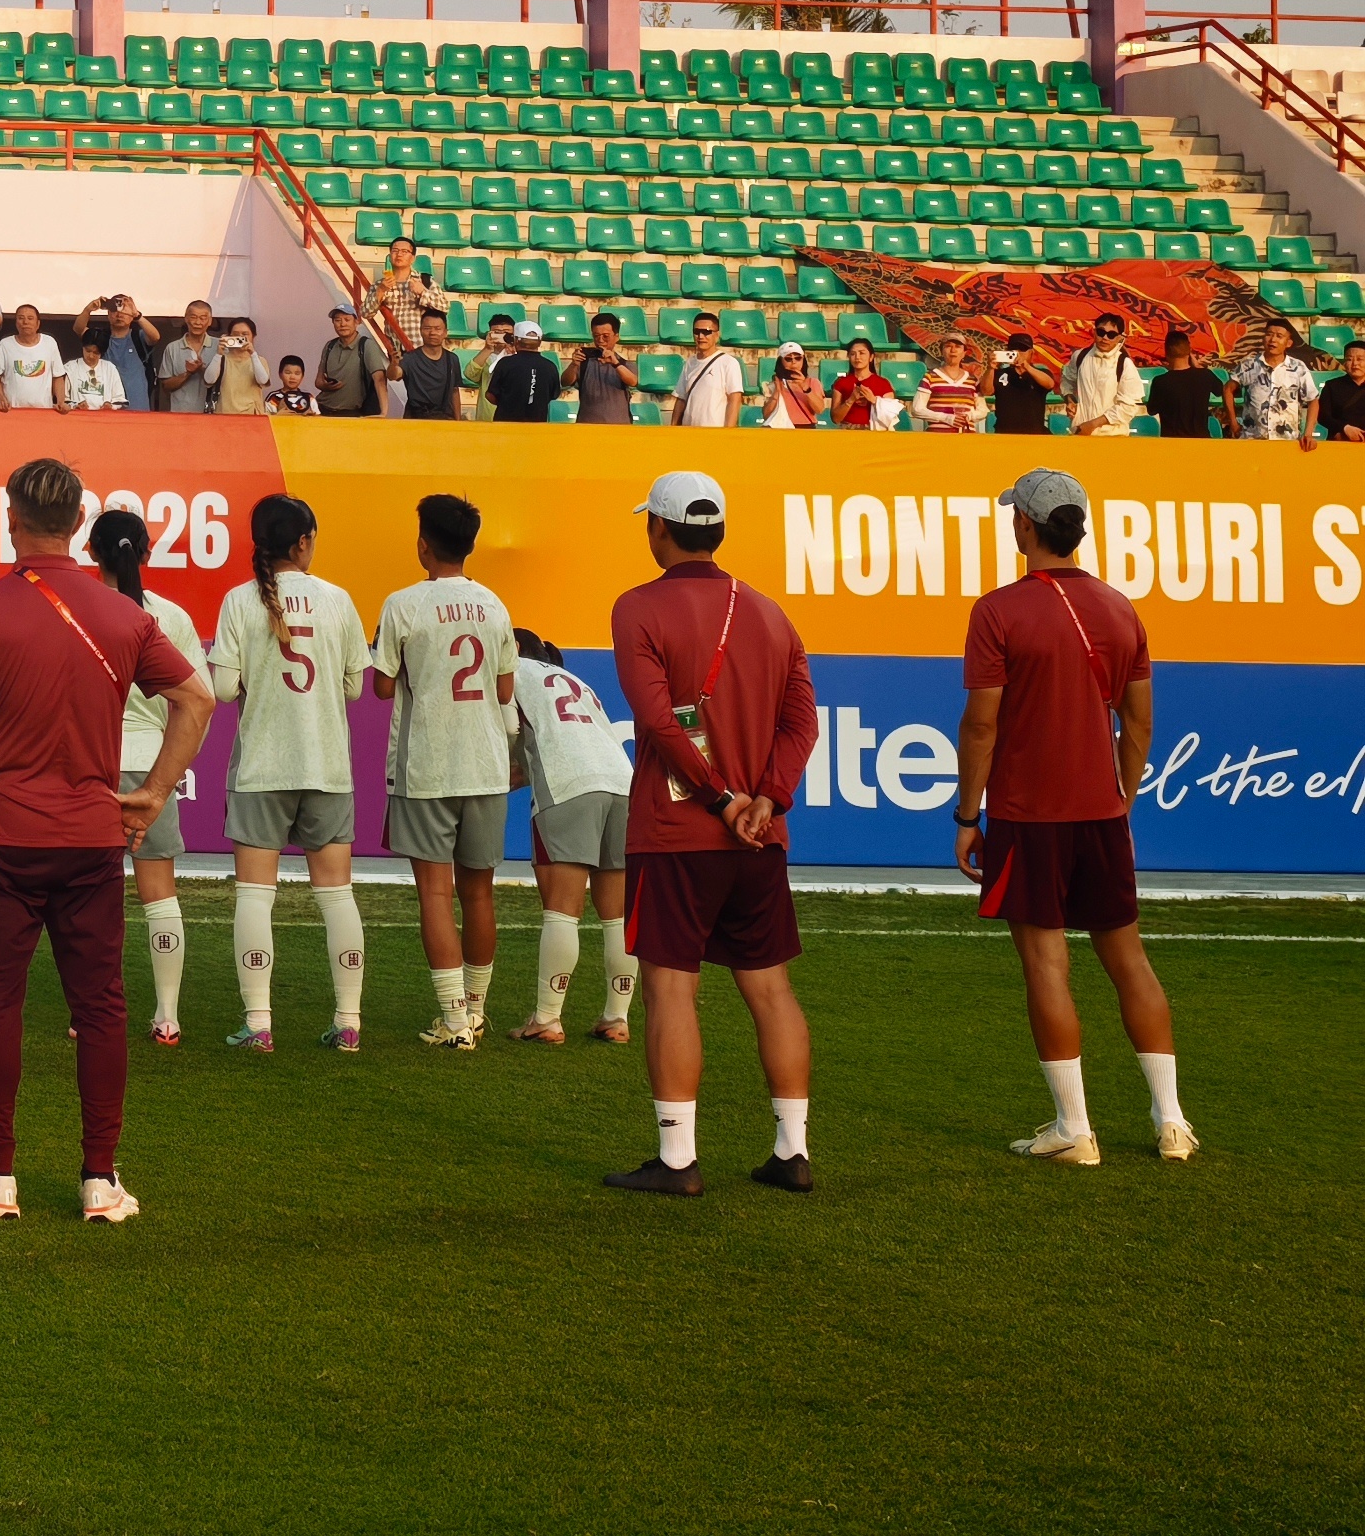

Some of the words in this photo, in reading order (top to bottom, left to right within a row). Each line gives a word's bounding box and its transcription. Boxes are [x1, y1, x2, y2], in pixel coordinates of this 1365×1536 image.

[998, 373, 1009, 386] 4
[1311, 503, 1365, 605] S
[282, 595, 300, 614] IU
[304, 595, 314, 614] L
[435, 603, 462, 624] LIU
[464, 602, 475, 621] X
[476, 604, 486, 623] B
[279, 626, 316, 694] 5
[449, 633, 485, 702] 2
[1196, 745, 1299, 806] the
